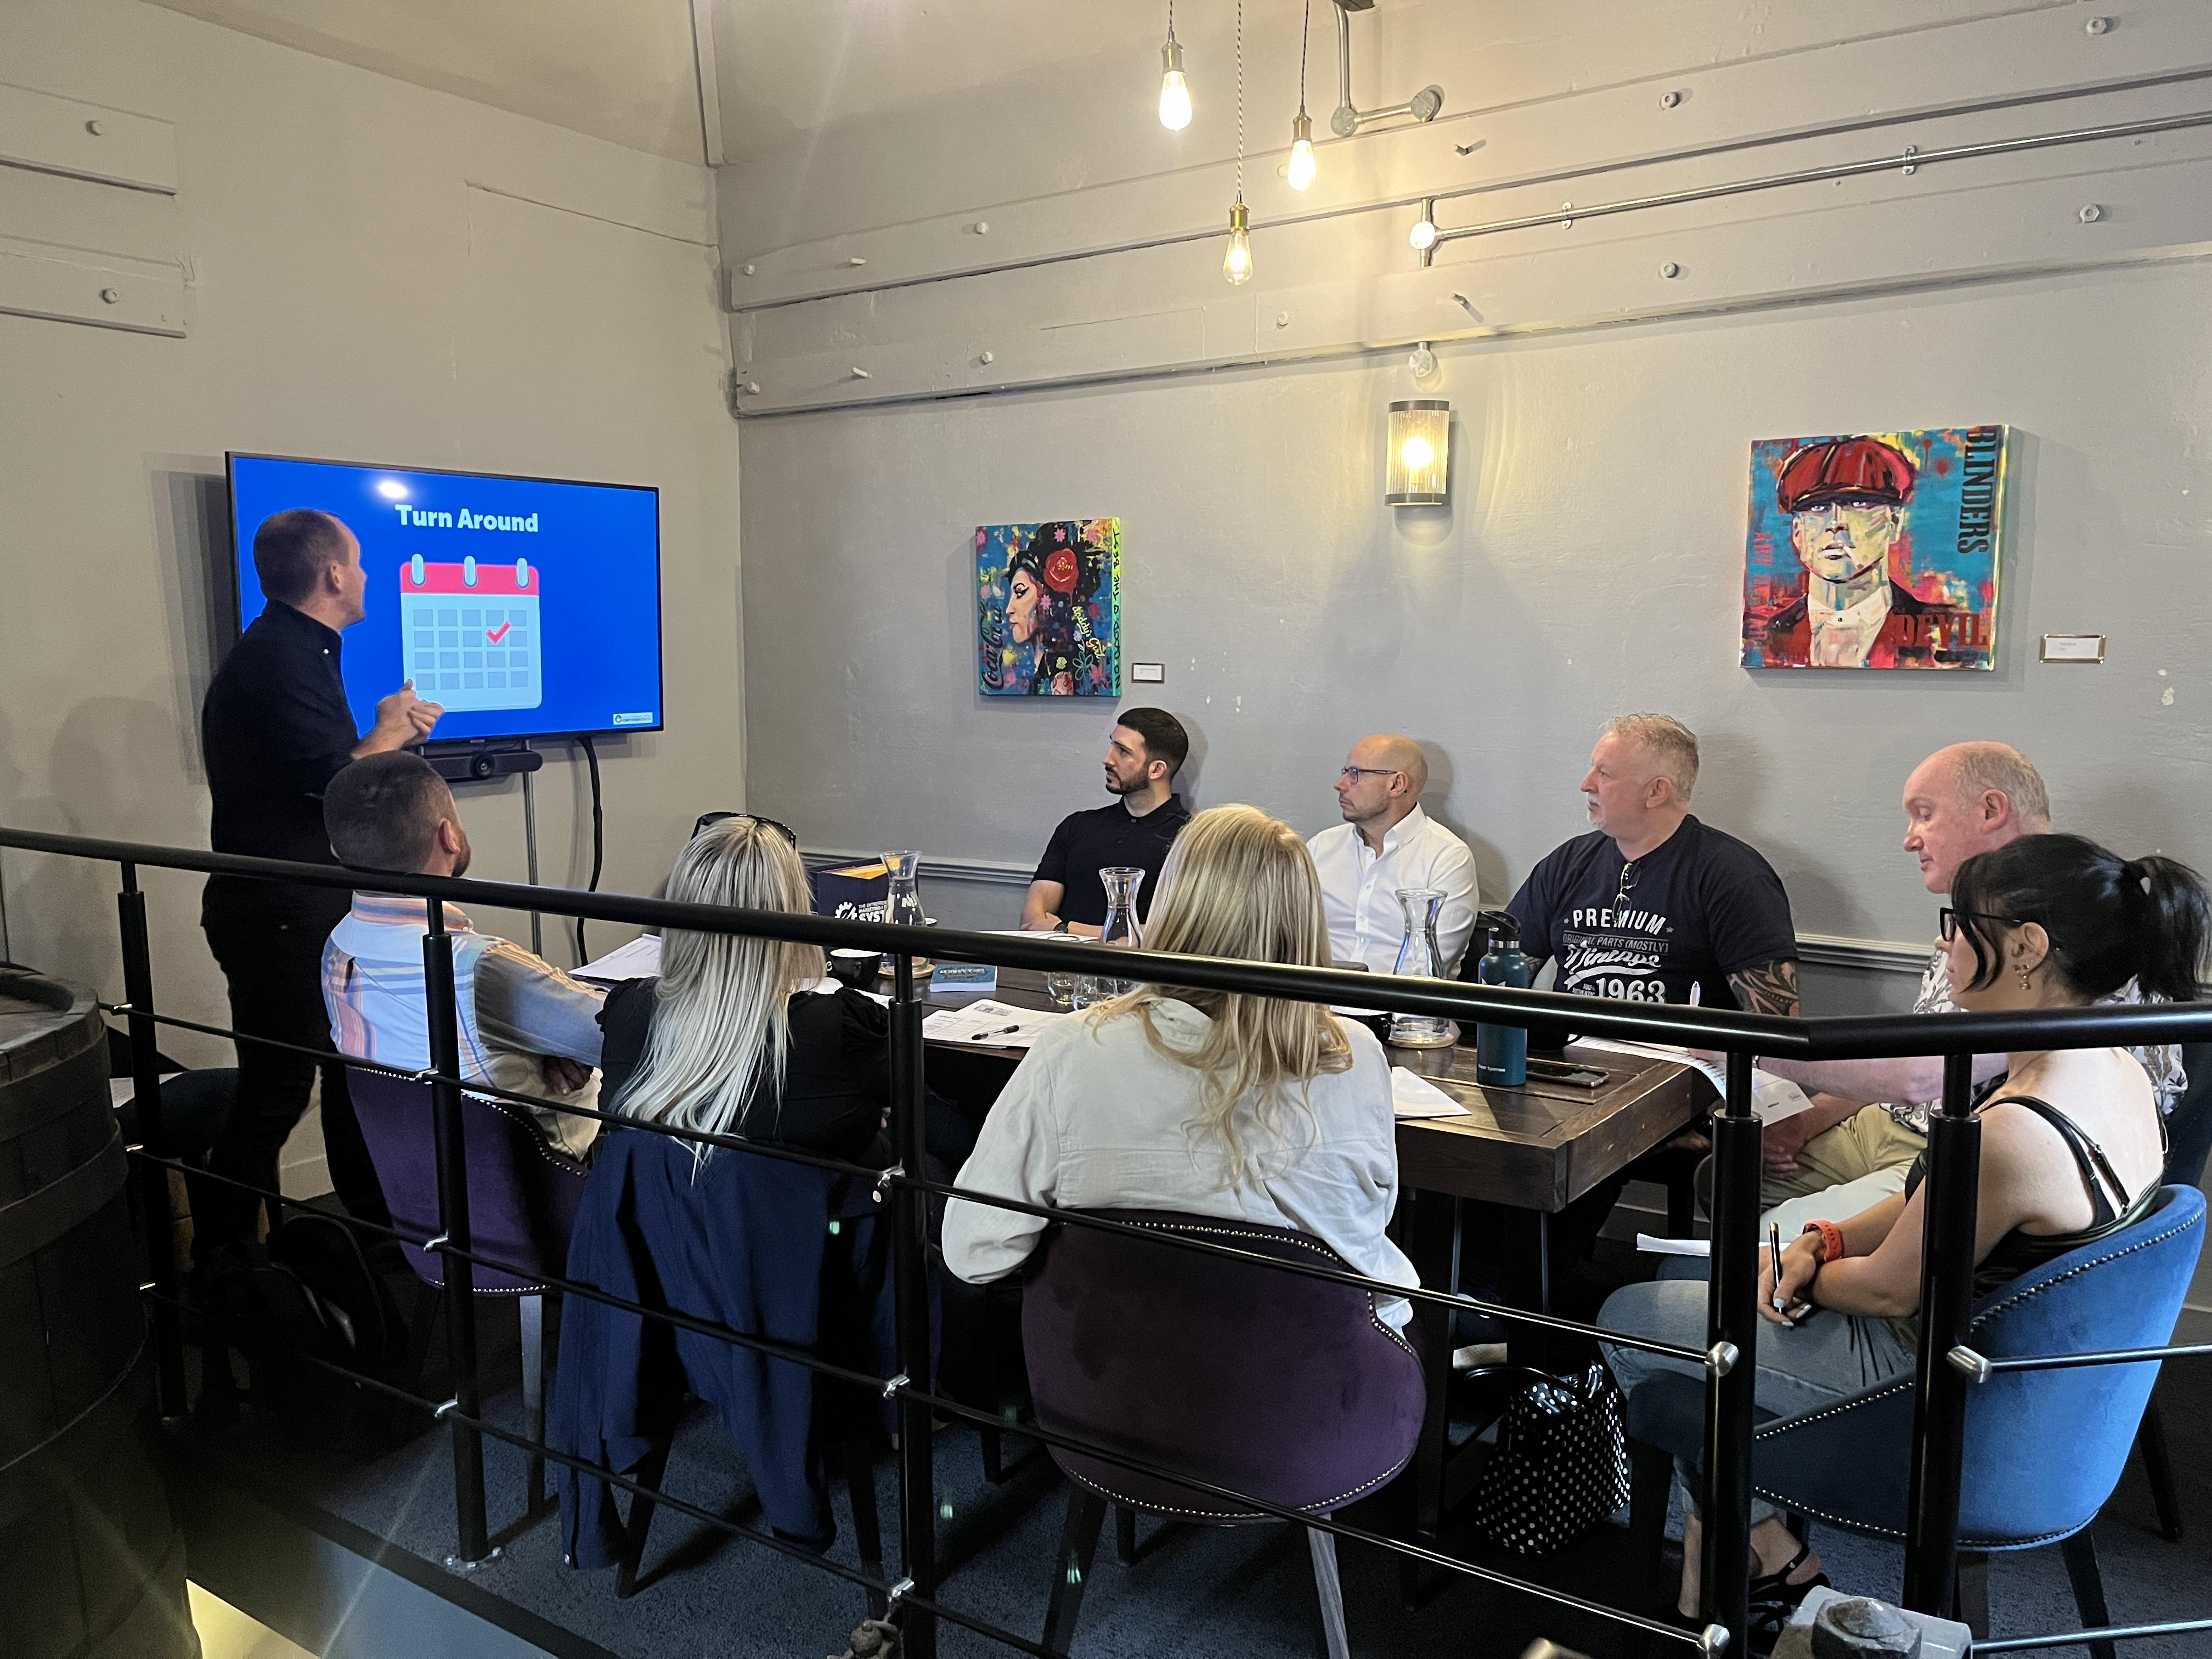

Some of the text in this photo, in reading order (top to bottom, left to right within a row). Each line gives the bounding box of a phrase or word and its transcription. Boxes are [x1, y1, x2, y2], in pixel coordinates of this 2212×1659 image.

[1957, 428, 1997, 554] BLINDERS
[394, 504, 539, 533] Turn Around
[1894, 613, 1989, 648] DEVIL
[859, 910, 885, 923] SYST
[1573, 908, 1667, 935] PREMIUM
[1562, 933, 1668, 953] ORIGINAL PARTS (MOSTLY)
[1564, 939, 1662, 975] Vintage
[1596, 977, 1667, 1004] 1963
